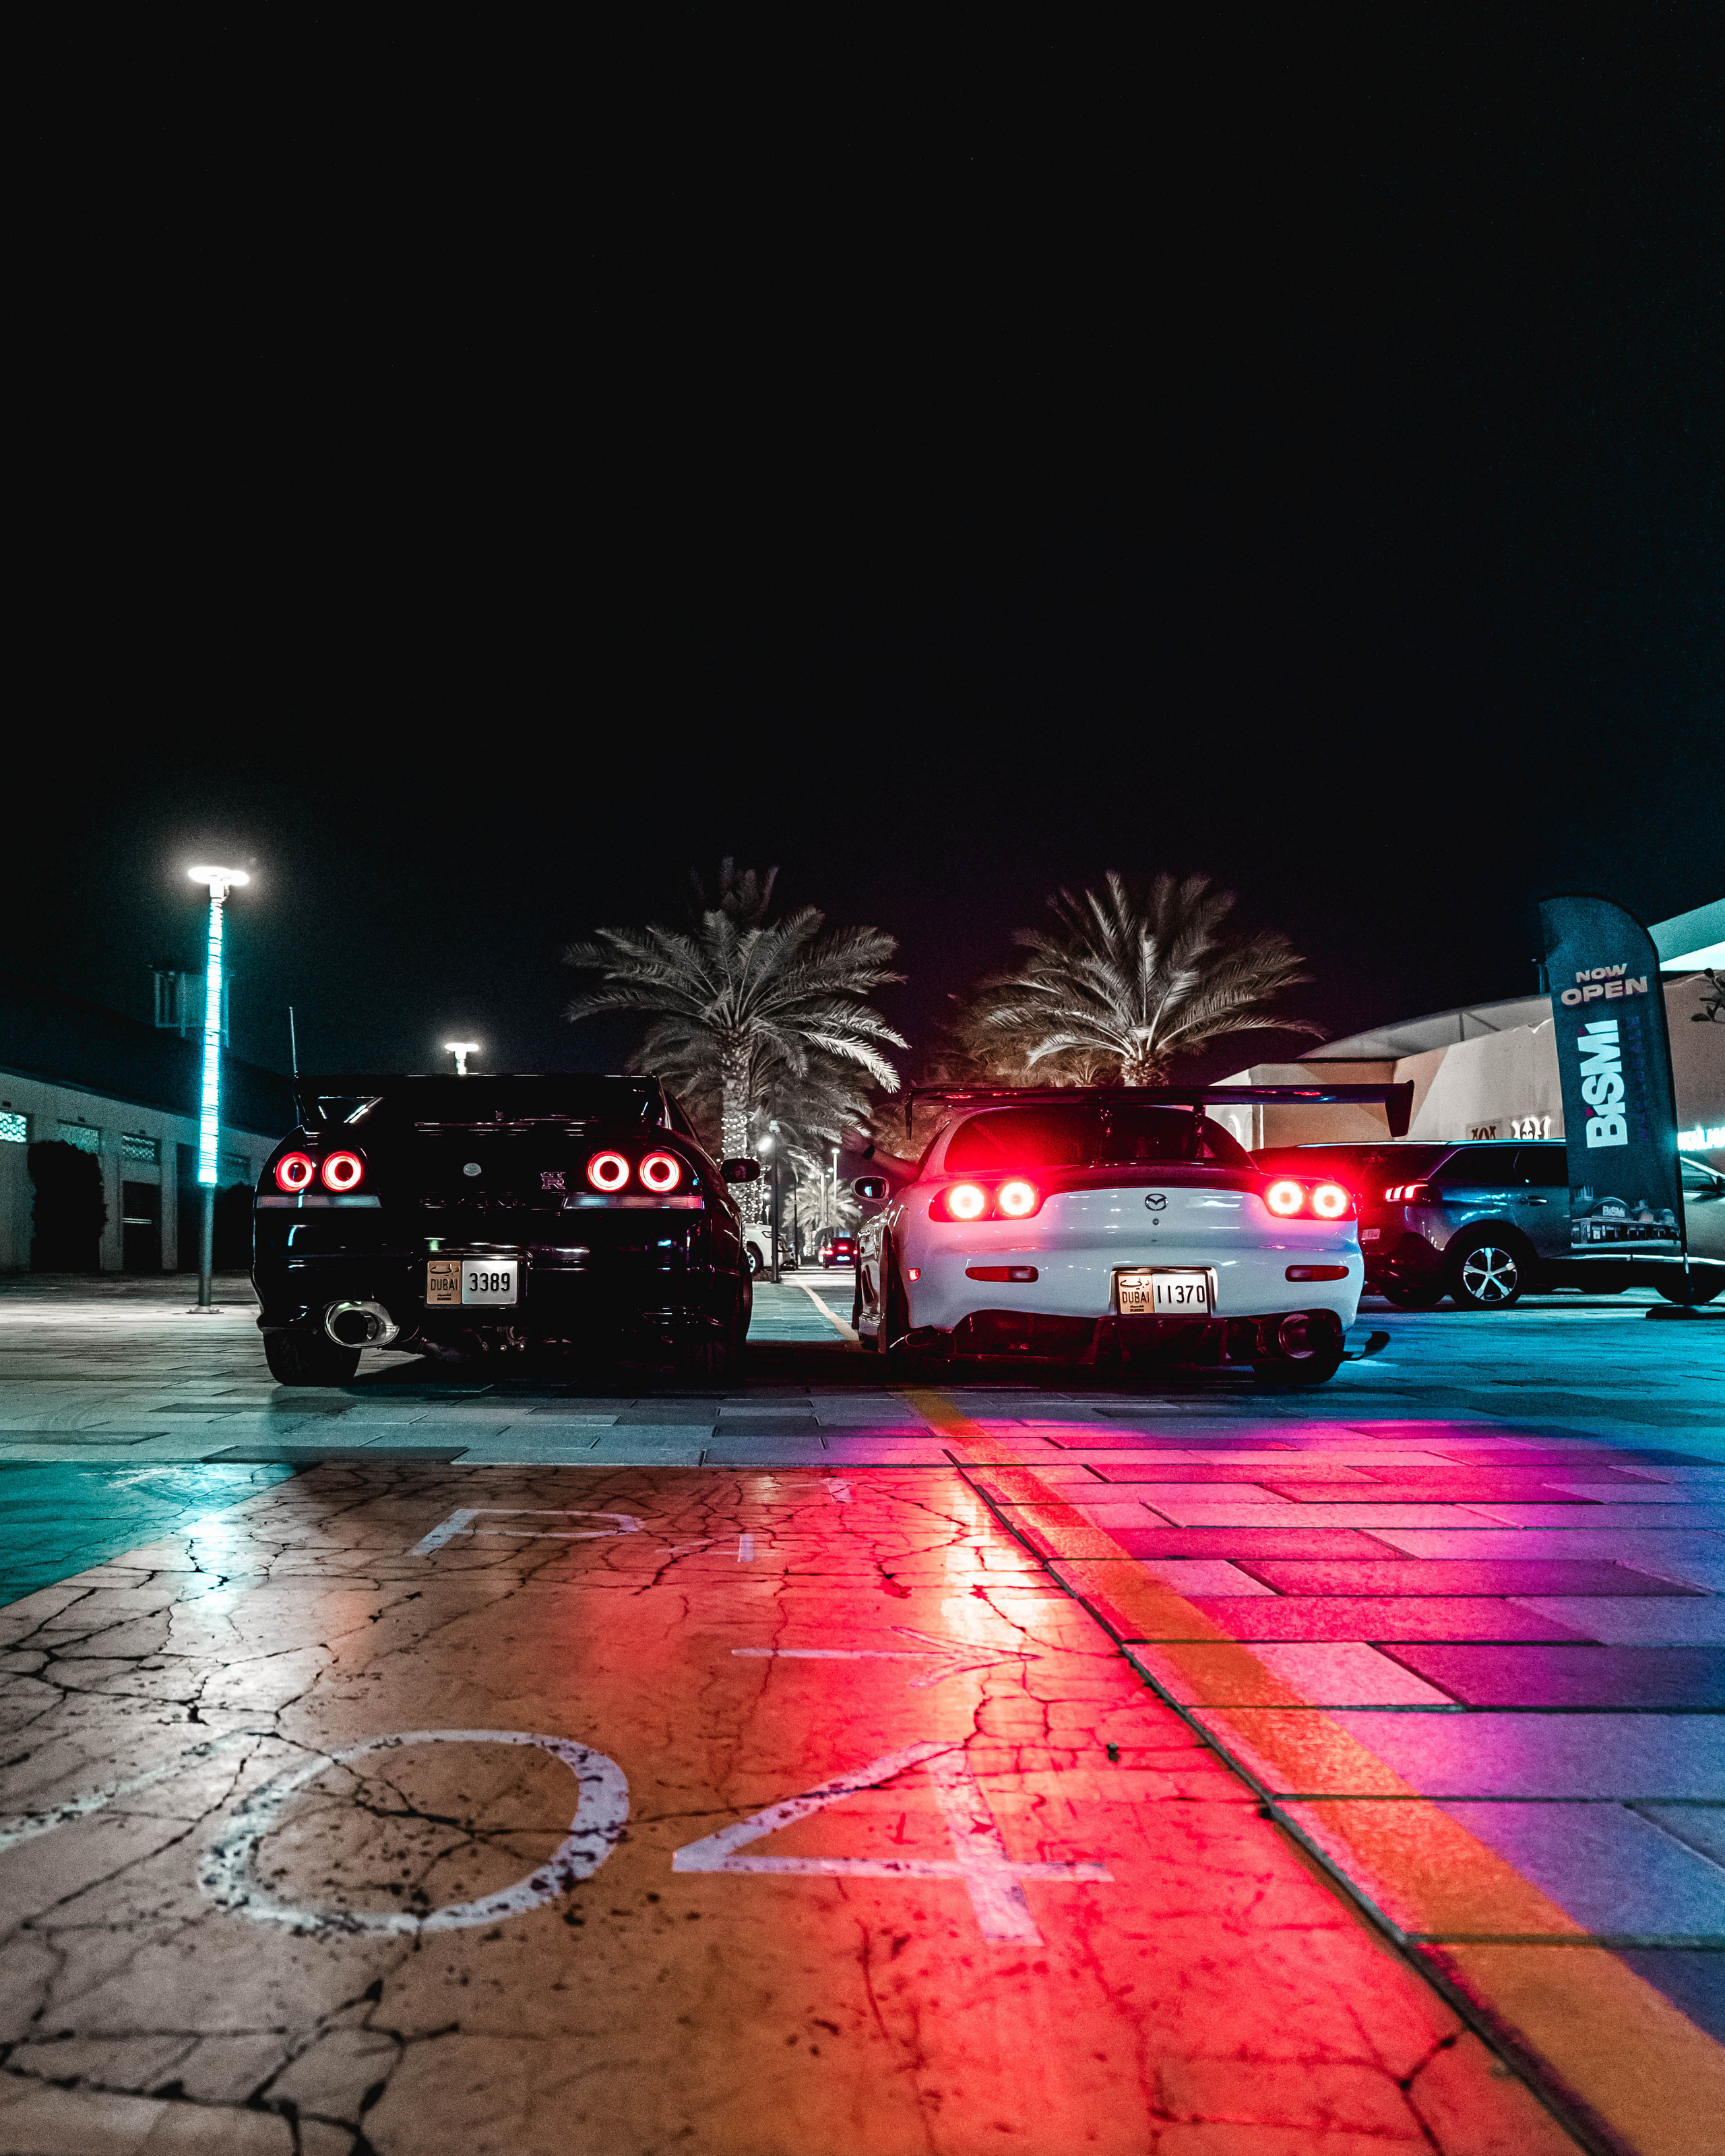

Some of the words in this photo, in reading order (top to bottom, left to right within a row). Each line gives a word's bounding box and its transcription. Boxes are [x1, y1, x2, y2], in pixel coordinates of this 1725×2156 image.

[1575, 963, 1628, 983] NOW
[1561, 976, 1648, 1006] OPEN
[431, 1278, 459, 1291] DUBAI
[469, 1272, 511, 1292] 3389
[1122, 1291, 1150, 1304] DUBAI
[1157, 1285, 1205, 1304] 11370
